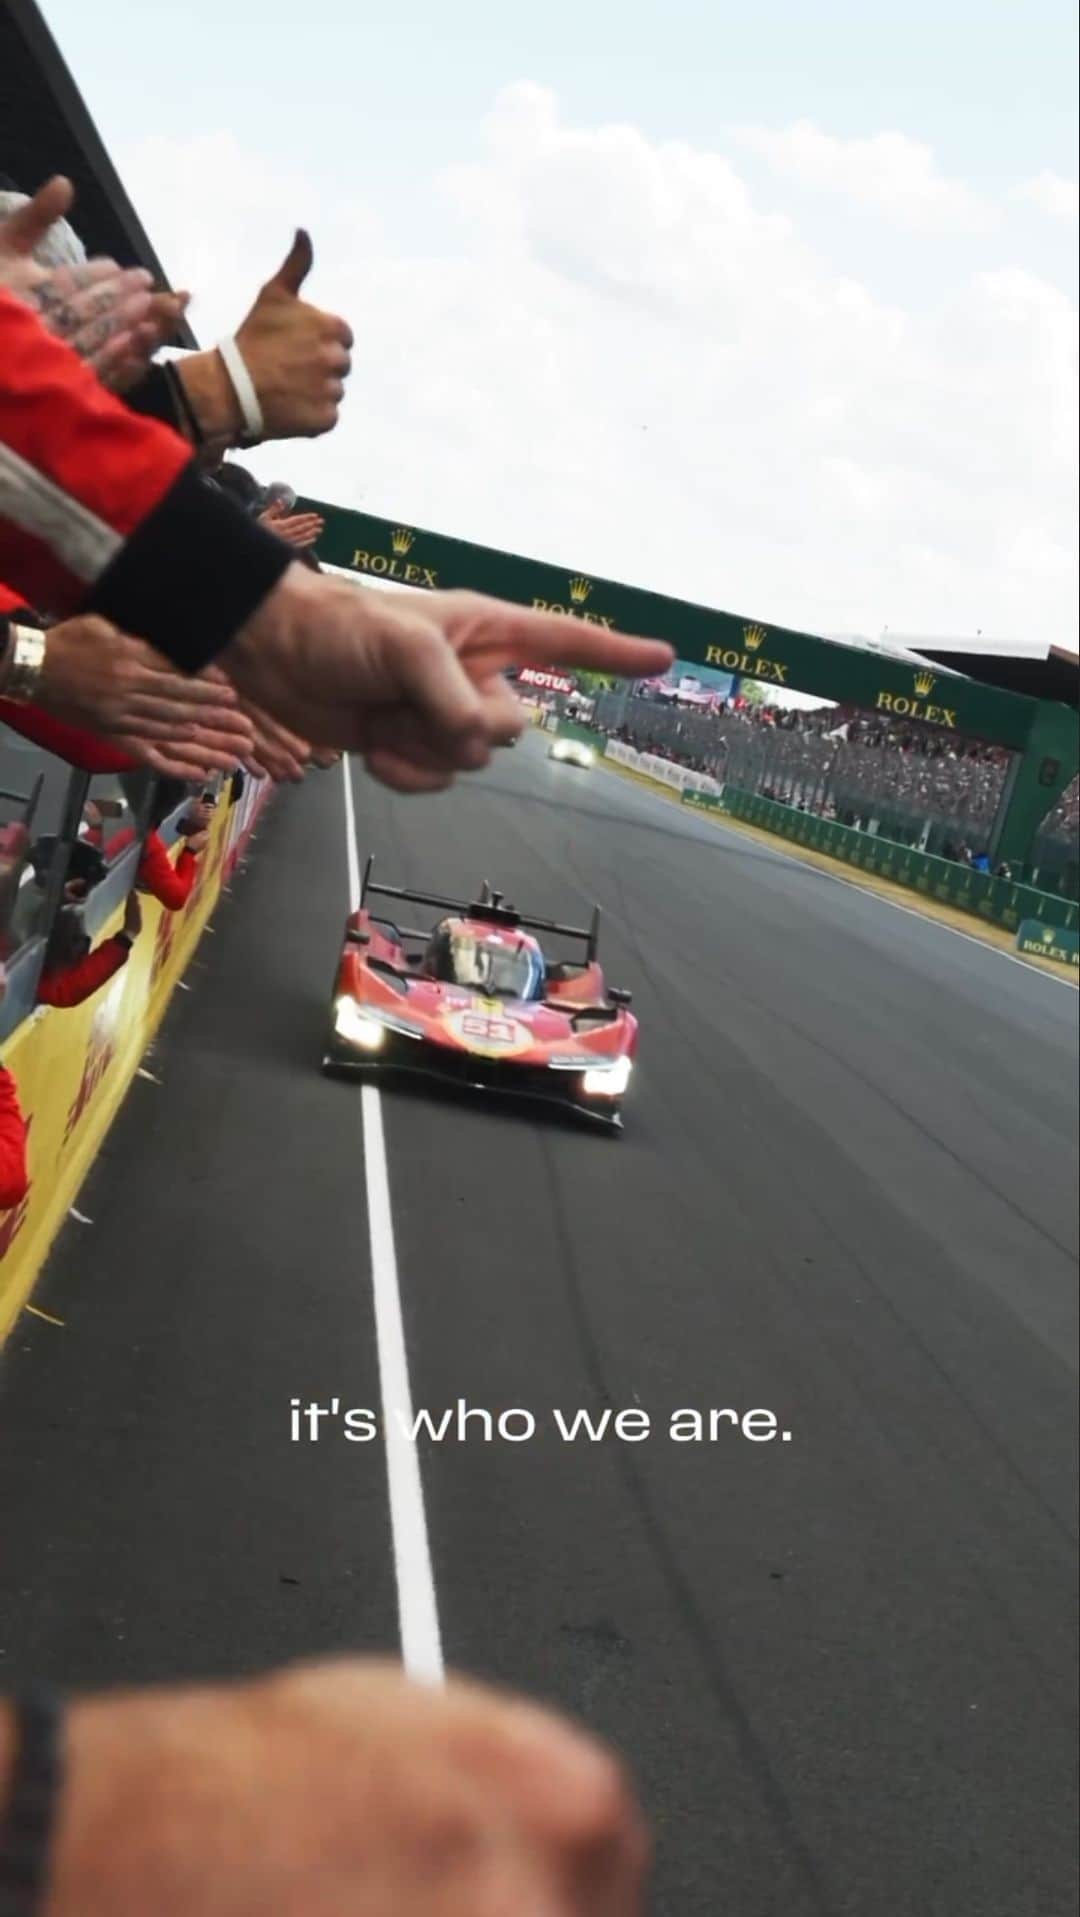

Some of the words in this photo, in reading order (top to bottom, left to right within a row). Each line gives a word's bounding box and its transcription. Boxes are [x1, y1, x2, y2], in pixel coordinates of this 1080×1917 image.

[351, 549, 438, 589] ROLEX
[519, 668, 571, 692] MOTUL
[705, 645, 788, 683] ROLEX
[876, 692, 956, 729] ROLEX
[1023, 939, 1068, 961] ROLEX
